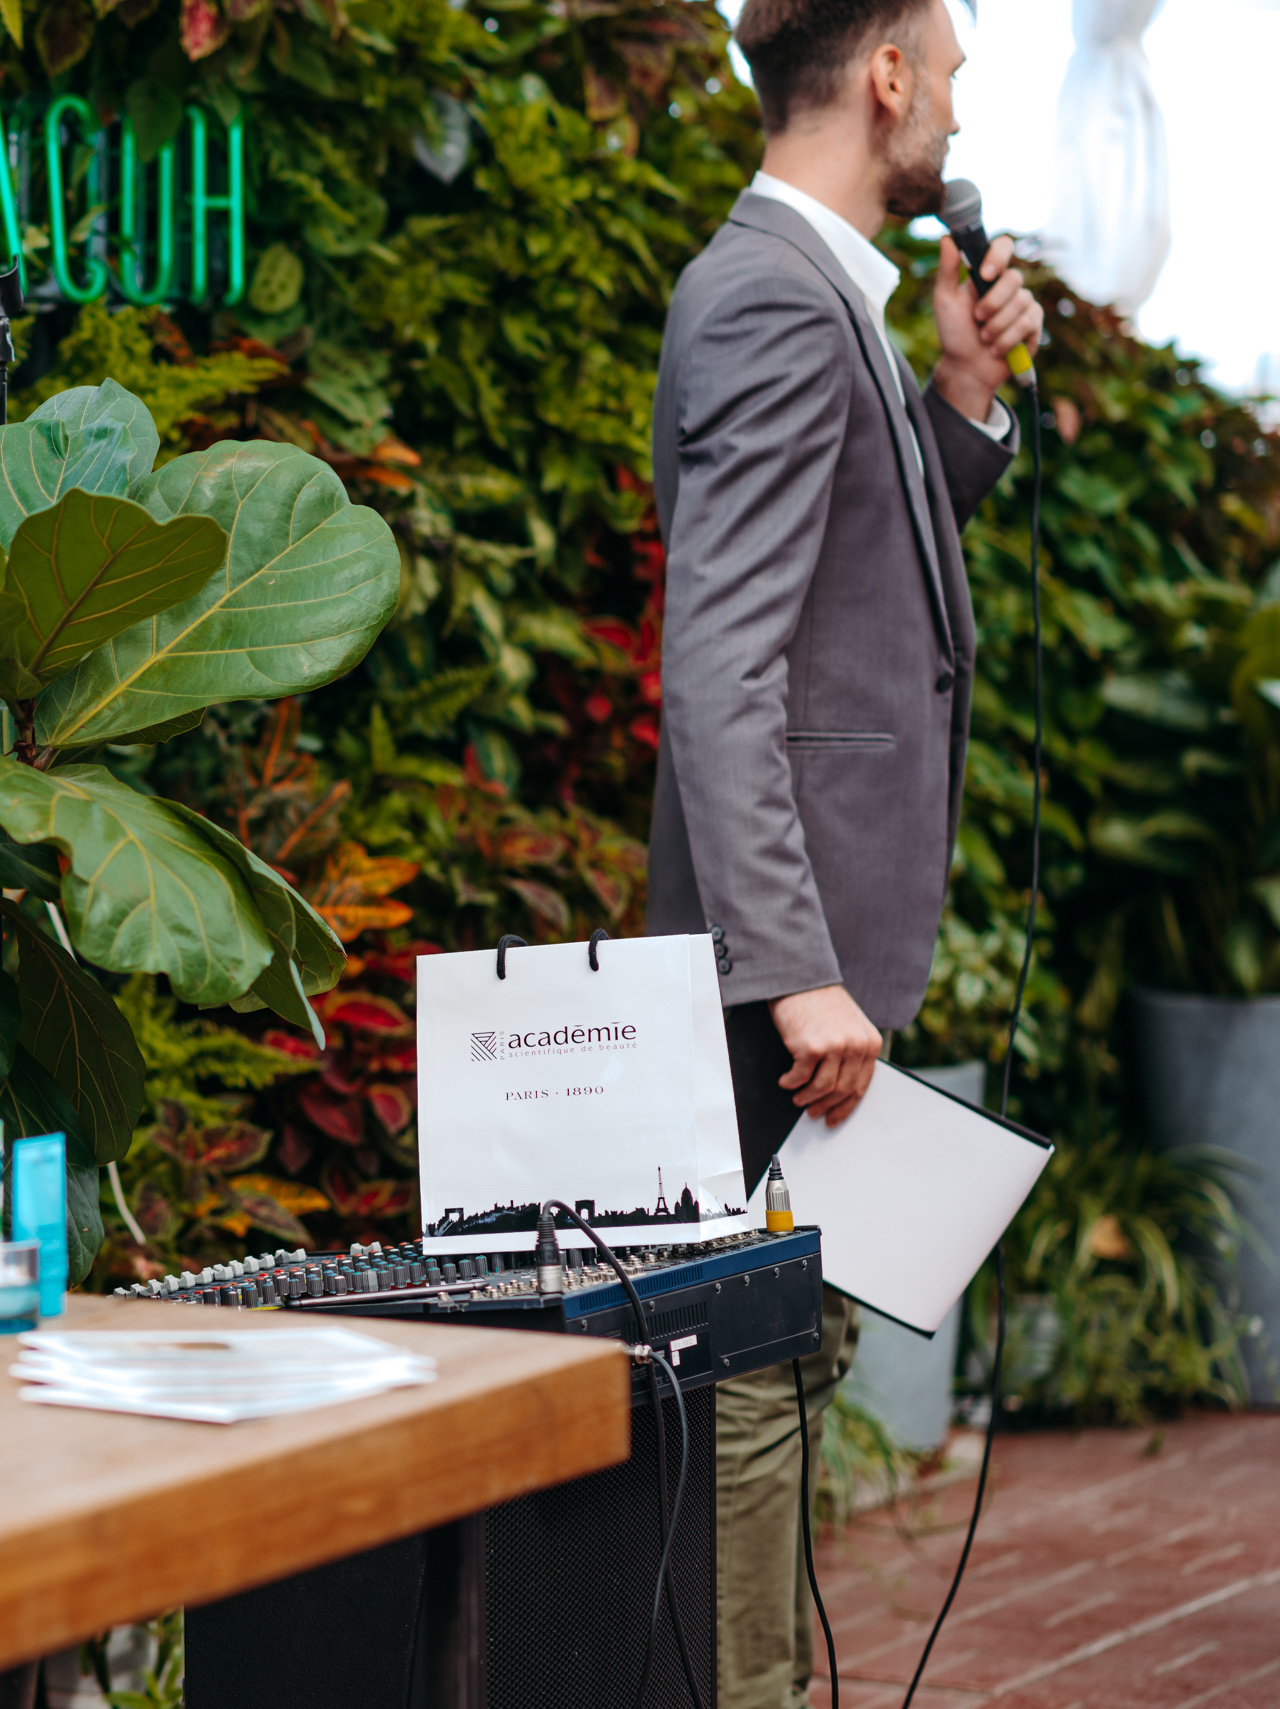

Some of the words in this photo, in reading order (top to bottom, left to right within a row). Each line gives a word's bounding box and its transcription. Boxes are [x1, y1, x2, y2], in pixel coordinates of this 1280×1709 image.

[509, 1046, 575, 1058] scientifique
[599, 1042, 637, 1051] beauté
[505, 1089, 549, 1101] PARIS
[565, 1085, 604, 1097] 1890
